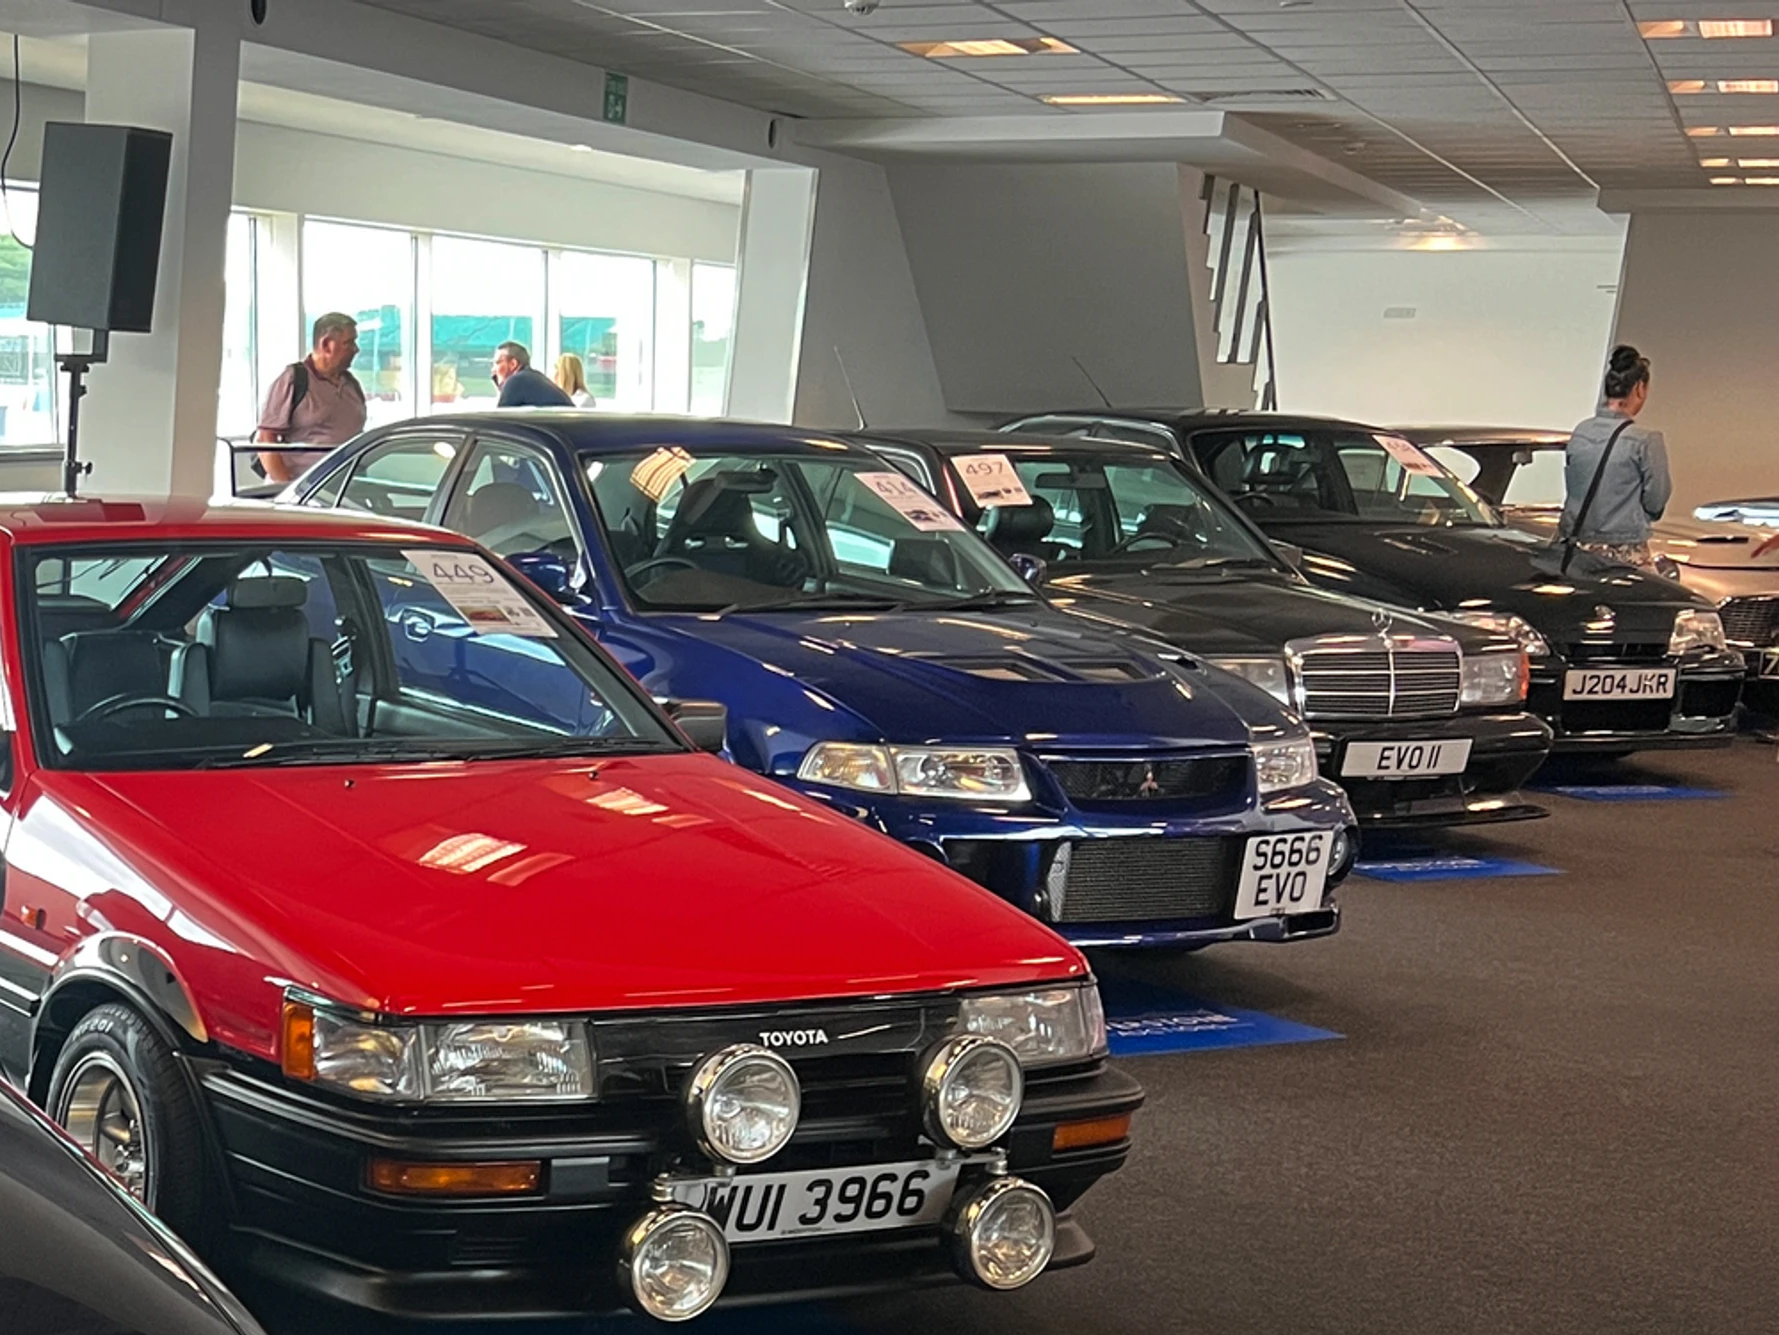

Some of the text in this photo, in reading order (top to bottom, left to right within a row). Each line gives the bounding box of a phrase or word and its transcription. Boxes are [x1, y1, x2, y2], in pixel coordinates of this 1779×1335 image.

[965, 461, 1003, 475] 497
[433, 562, 495, 584] 449
[1377, 745, 1424, 770] EVO
[1252, 834, 1323, 871] S666
[1254, 871, 1307, 907] EVO
[759, 1029, 829, 1047] TOYOTA
[706, 1169, 931, 1232] WUI 3966
